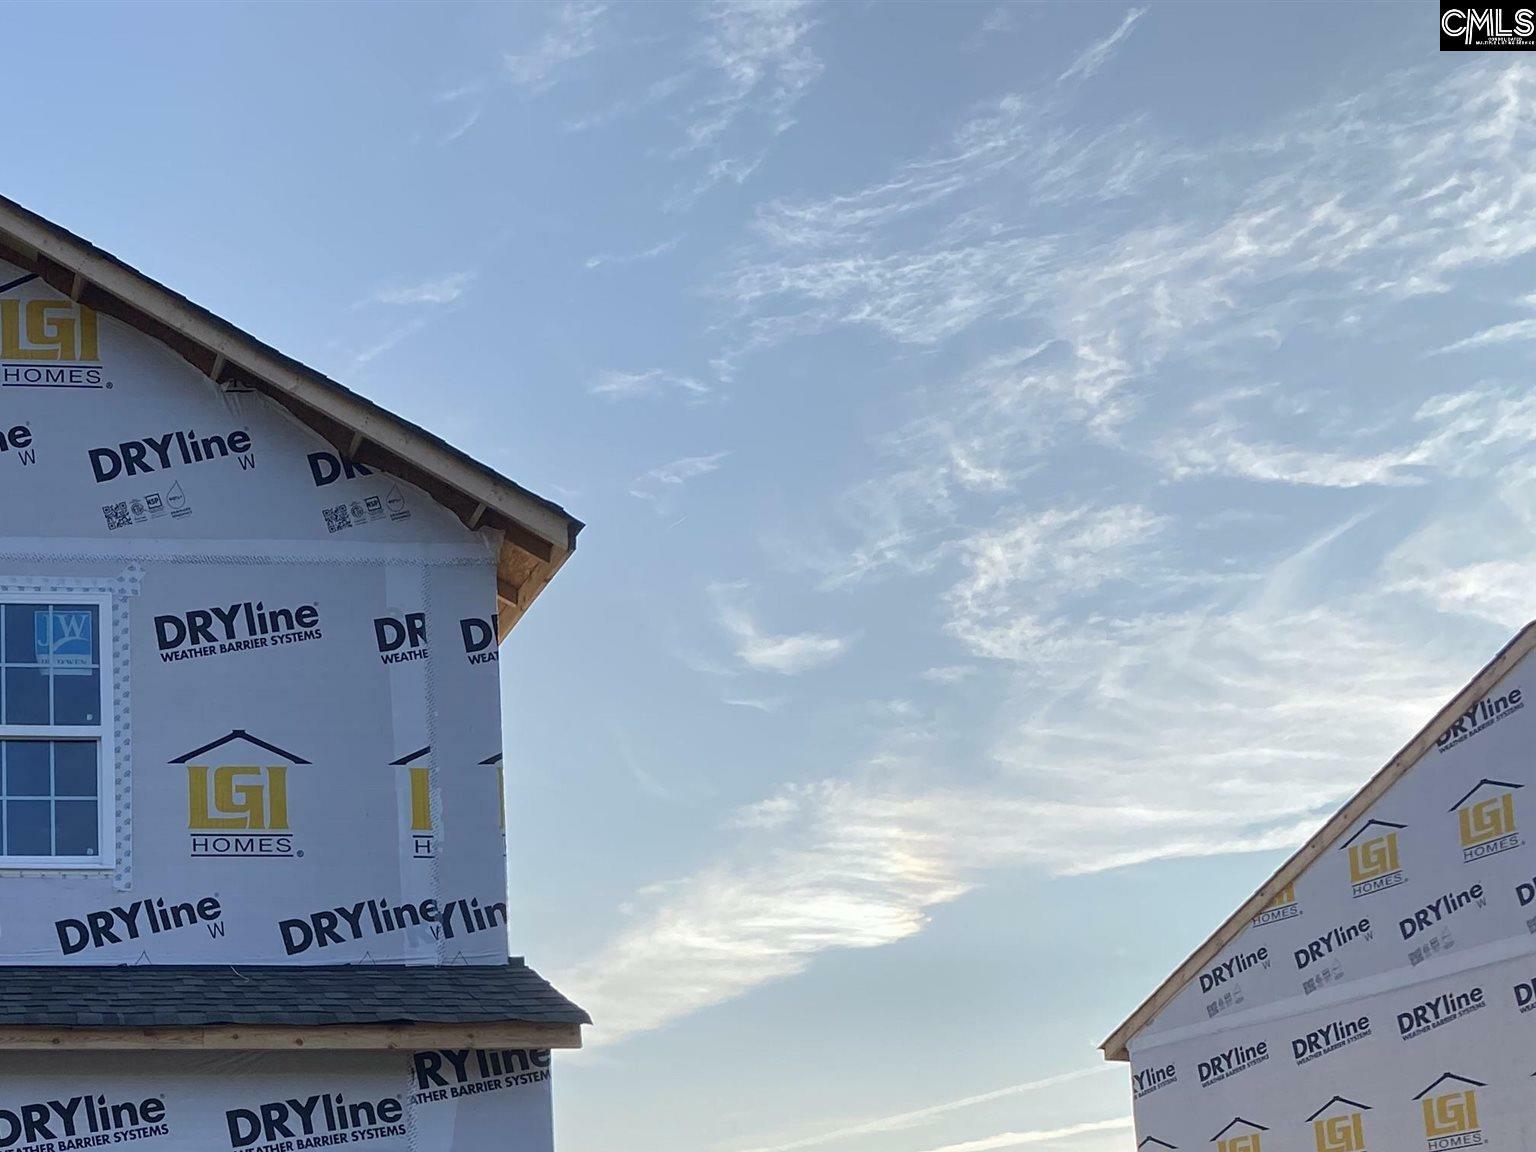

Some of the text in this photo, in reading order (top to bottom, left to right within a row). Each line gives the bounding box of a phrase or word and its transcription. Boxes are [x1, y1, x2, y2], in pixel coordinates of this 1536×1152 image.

[0, 298, 100, 361] LGI
[3, 367, 102, 385] HOMES
[88, 429, 251, 484] DRYline
[153, 602, 319, 650] DRYline
[160, 629, 322, 664] WEATHER BARRIER SYSTEMS
[187, 766, 289, 830] LGI
[1458, 793, 1515, 846] LGI
[192, 837, 292, 853] HOMES
[1348, 832, 1400, 884] LGI
[1463, 835, 1520, 860] HOMES
[1352, 874, 1404, 897] HOMES
[55, 897, 221, 955] DRYline
[1399, 883, 1484, 940] DRYline
[1294, 918, 1371, 970] DRYline
[1200, 946, 1269, 993] DRYline
[1397, 986, 1484, 1035] DRYline
[1292, 1015, 1370, 1060] DRYline
[1198, 1041, 1267, 1083] DRYline
[459, 1079, 504, 1098] BARRIER
[58, 1133, 110, 1152] BARRIER
[113, 1123, 169, 1142] SYSTEMS
[226, 1095, 402, 1149] DRYline
[296, 1133, 348, 1151] BARRIER
[350, 1123, 406, 1142] SYSTEMS
[1422, 1090, 1479, 1138] LGI
[1428, 1132, 1483, 1151] HOMES
